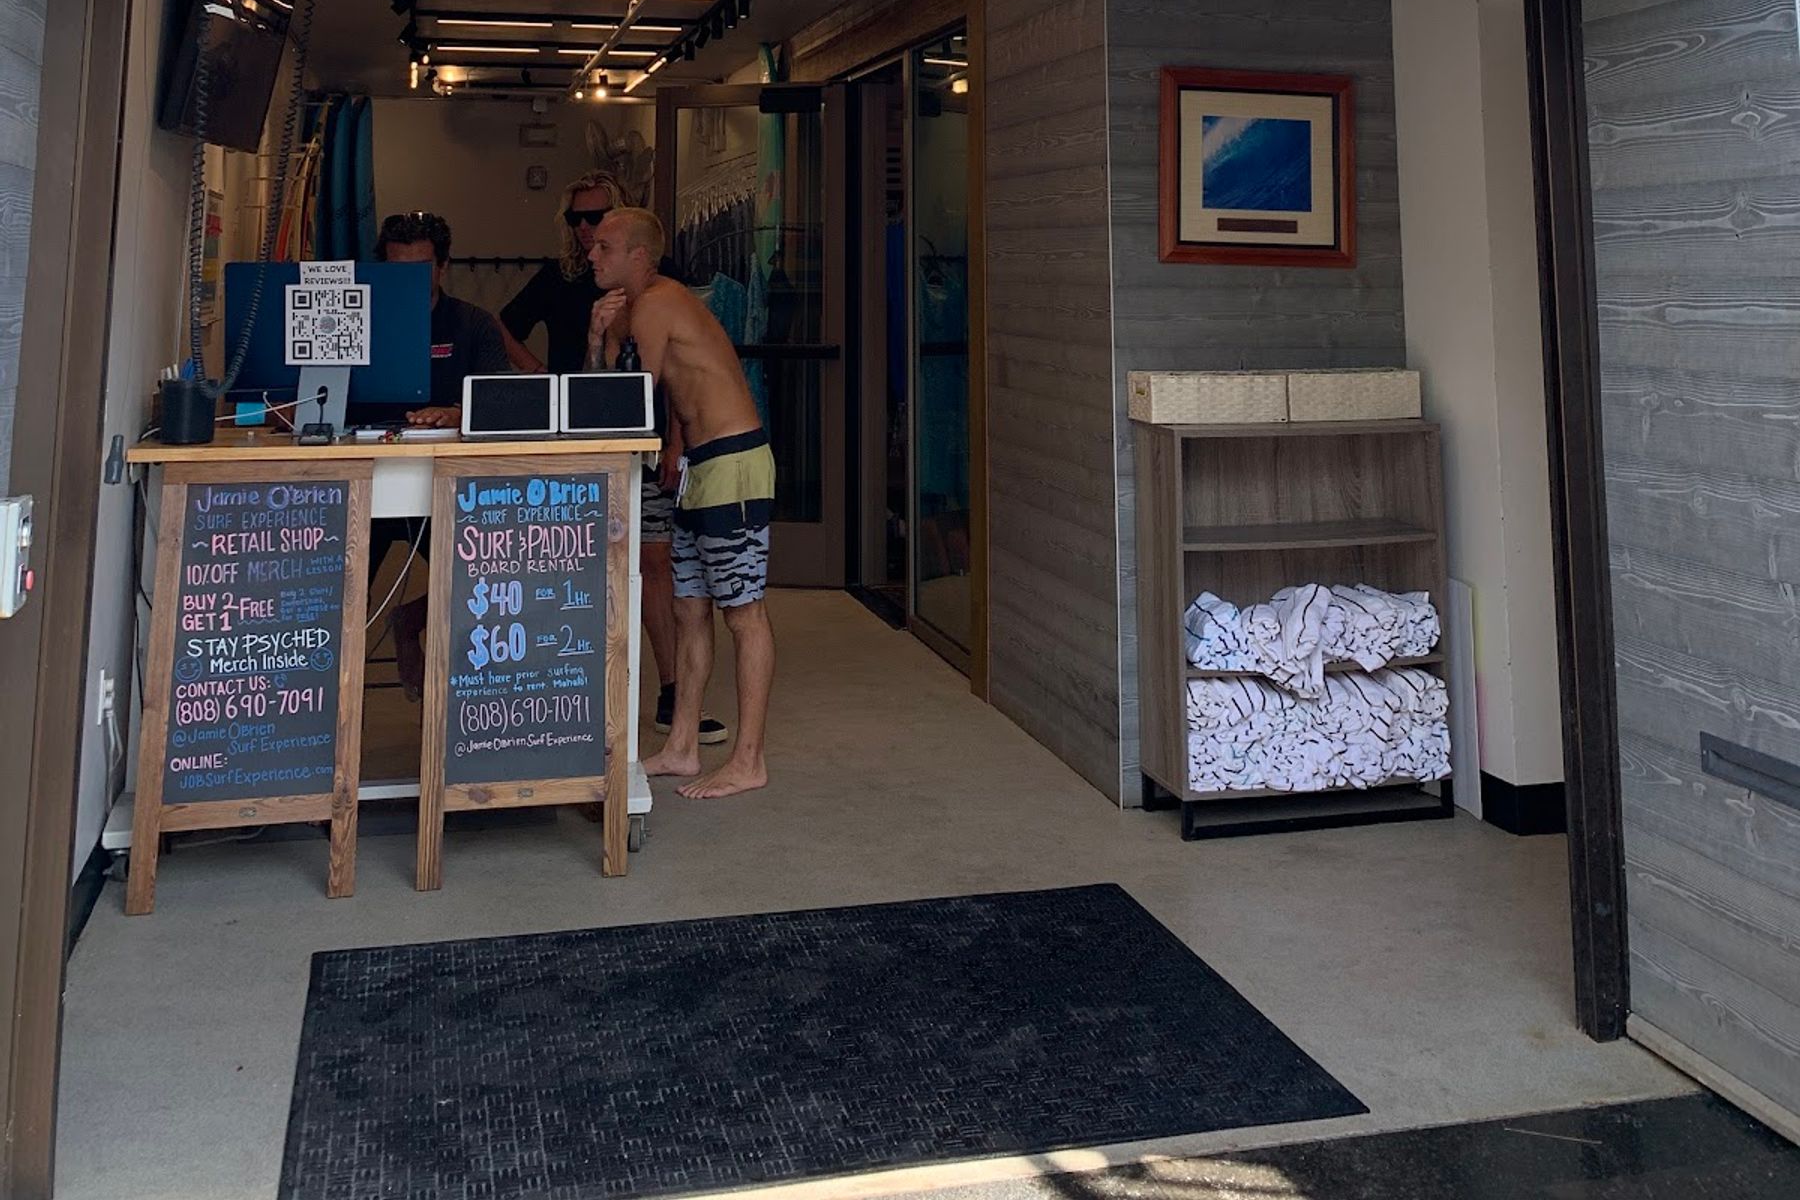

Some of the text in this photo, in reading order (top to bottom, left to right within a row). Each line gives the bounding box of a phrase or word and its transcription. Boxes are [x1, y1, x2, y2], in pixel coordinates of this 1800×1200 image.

[307, 265, 347, 273] WE LOVE
[196, 486, 260, 513] Jamie
[457, 478, 600, 512] Jamie O'Brien
[194, 507, 328, 531] SURF EXPERIENCE
[481, 504, 583, 525] SURF EXPERIENCE
[211, 527, 324, 556] RETAIL SHOP
[457, 525, 514, 561] SURF
[528, 522, 597, 559] PADDLE
[468, 558, 585, 577] BOARD RENTAL
[183, 592, 239, 611] BUY 2
[239, 597, 275, 620] FREE
[467, 576, 523, 620] $40
[535, 588, 556, 598] FOR
[182, 612, 232, 632] GET 1
[186, 628, 330, 657] STAY PSYCHED
[467, 622, 526, 670] $60
[559, 624, 577, 652] 2
[210, 650, 309, 673] Merch Inside
[488, 671, 511, 684] have
[516, 671, 540, 684] prior
[547, 663, 585, 677] surfing
[175, 675, 271, 699] CONTACT US:
[455, 687, 508, 698] experience
[513, 684, 523, 692] to
[170, 753, 229, 772] ONLINE:
